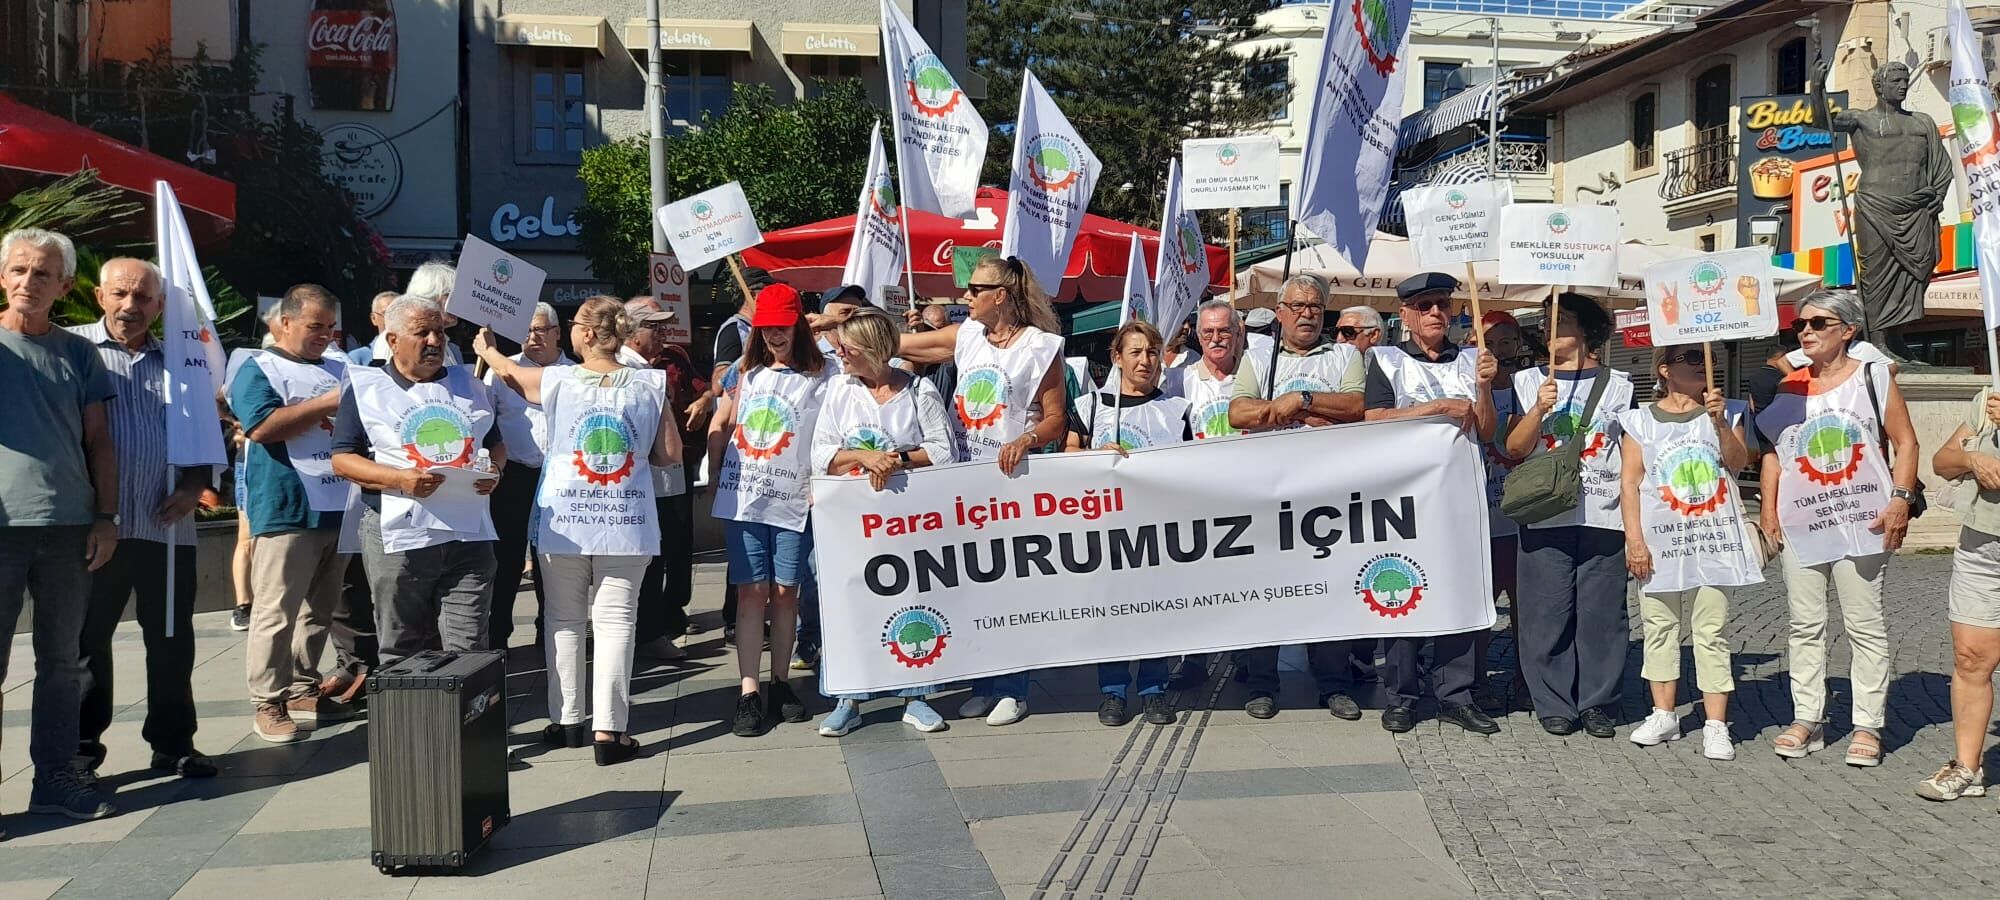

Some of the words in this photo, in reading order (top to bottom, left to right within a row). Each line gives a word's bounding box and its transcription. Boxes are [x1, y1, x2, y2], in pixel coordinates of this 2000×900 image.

[308, 16, 392, 52] Coca-Cola
[518, 27, 574, 44] GeLatte
[805, 35, 857, 52] GeLatte
[1756, 127, 1777, 149] &
[1195, 176, 1207, 185] BİR
[1228, 175, 1260, 183] ÇALIŞTIK
[1190, 186, 1218, 194] ONURLU
[1219, 184, 1251, 193] YAŞAMAK
[1029, 189, 1079, 211] EMEKLİLERİN
[1449, 222, 1478, 231] VERDİK
[678, 229, 691, 240] SİZ
[706, 230, 722, 241] İÇİN
[703, 242, 717, 254] BİZ
[1510, 241, 1562, 249] EMEKLİLER
[1563, 242, 1611, 252] SUSTUKÇA
[1530, 251, 1585, 260] YOKSULLUK
[1540, 262, 1571, 272] BÜYÜR
[471, 290, 499, 307] SADAKA
[1928, 291, 1979, 301] GELATERIA
[1695, 311, 1722, 324] SÖZ
[434, 454, 453, 462] 2017
[740, 461, 797, 480] EMEKLİLERİN
[1825, 463, 1843, 473] 2017
[729, 472, 775, 488] SENDİKASI
[556, 488, 576, 498] TÜM
[580, 487, 646, 499] EMEKLİLERİN
[756, 486, 790, 501] ŞUBESİ
[1688, 495, 1705, 503] 2017
[570, 502, 628, 513] SENDİKASI
[1793, 495, 1815, 509] TÜM
[861, 511, 943, 538] Para
[955, 496, 1021, 530] İçin
[1033, 487, 1124, 520] Değil
[556, 514, 604, 525] ANTALYA
[608, 513, 646, 527] ŞUBESİ
[1652, 522, 1675, 535] TÜM
[864, 514, 1255, 597] ONURUMUZ
[1279, 491, 1417, 560] İÇİN
[1671, 531, 1726, 546] SENDİKASI
[1661, 545, 1706, 559] ANTALYA
[1709, 541, 1744, 555] ŞUBES
[973, 615, 1005, 631] TÜM
[1009, 604, 1106, 627] EMEKLİLERİN
[1110, 597, 1188, 617] SENDİKASI
[1193, 590, 1259, 608] ANTALYA
[1263, 581, 1329, 602] ŞUBEESİ
[912, 650, 929, 659] 2017
